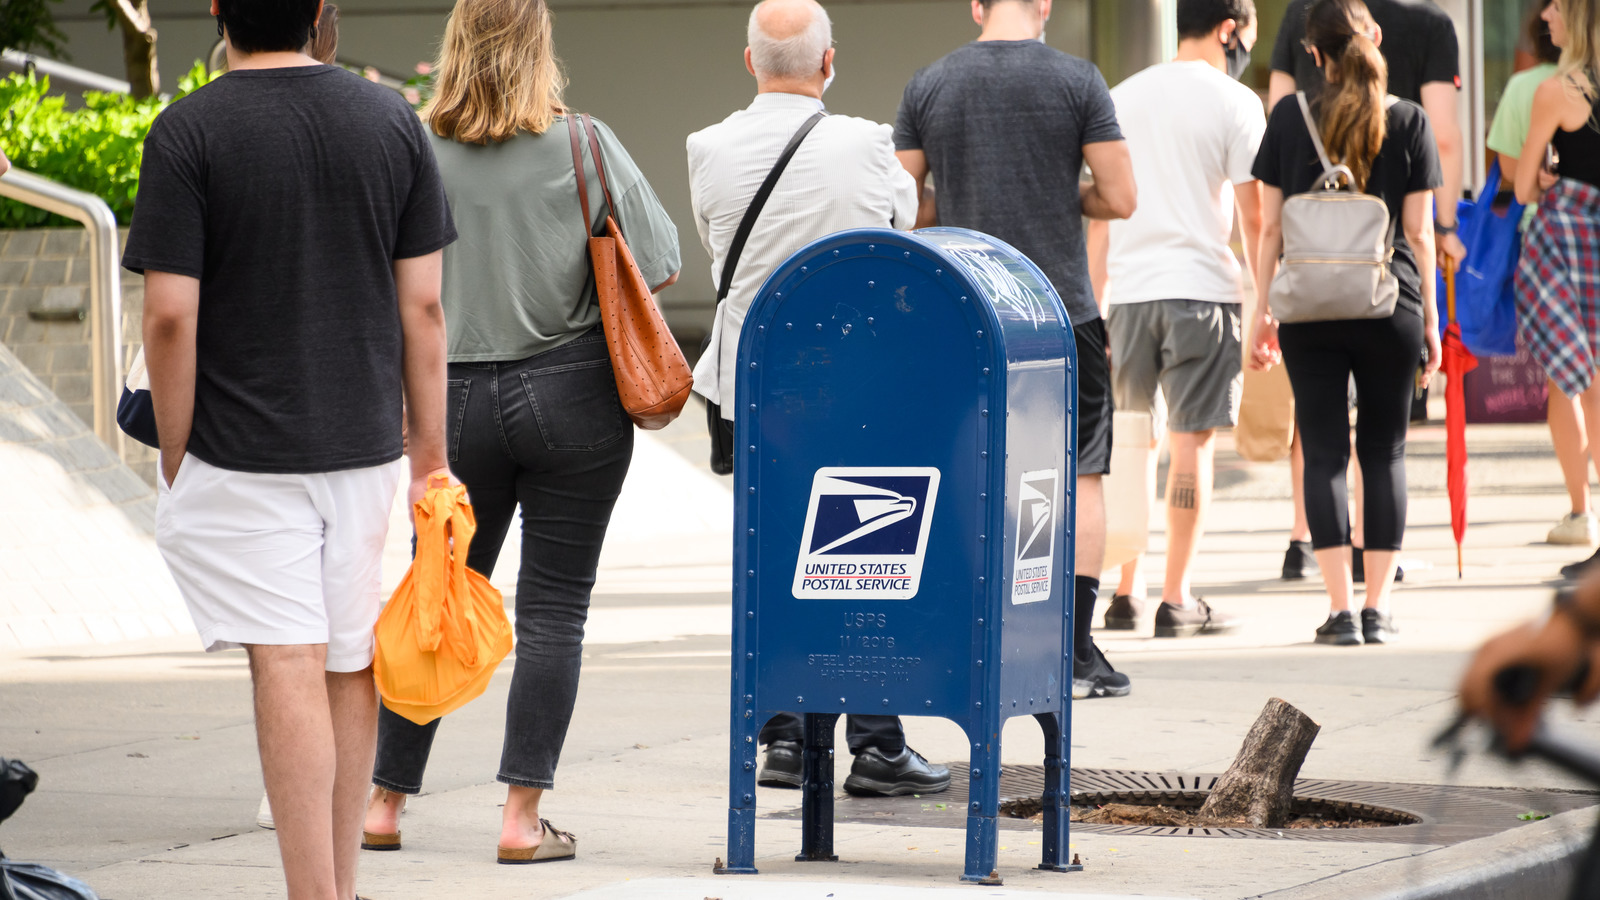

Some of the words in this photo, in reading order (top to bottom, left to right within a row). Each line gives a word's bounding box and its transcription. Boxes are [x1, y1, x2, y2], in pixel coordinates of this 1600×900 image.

[805, 564, 857, 575] UNITED
[859, 564, 907, 575] STATES
[1016, 568, 1032, 580] UNITED
[1032, 566, 1048, 578] STATES
[802, 579, 852, 590] POSTAL
[855, 579, 911, 590] SERVICE
[1015, 584, 1031, 595] POSTAL
[1031, 581, 1048, 593] SERVICE
[844, 612, 887, 628] USPS
[807, 653, 844, 666] STEEL
[848, 655, 887, 668] CRAFT
[890, 656, 922, 668] CORP
[820, 669, 888, 683] HARTFORD
